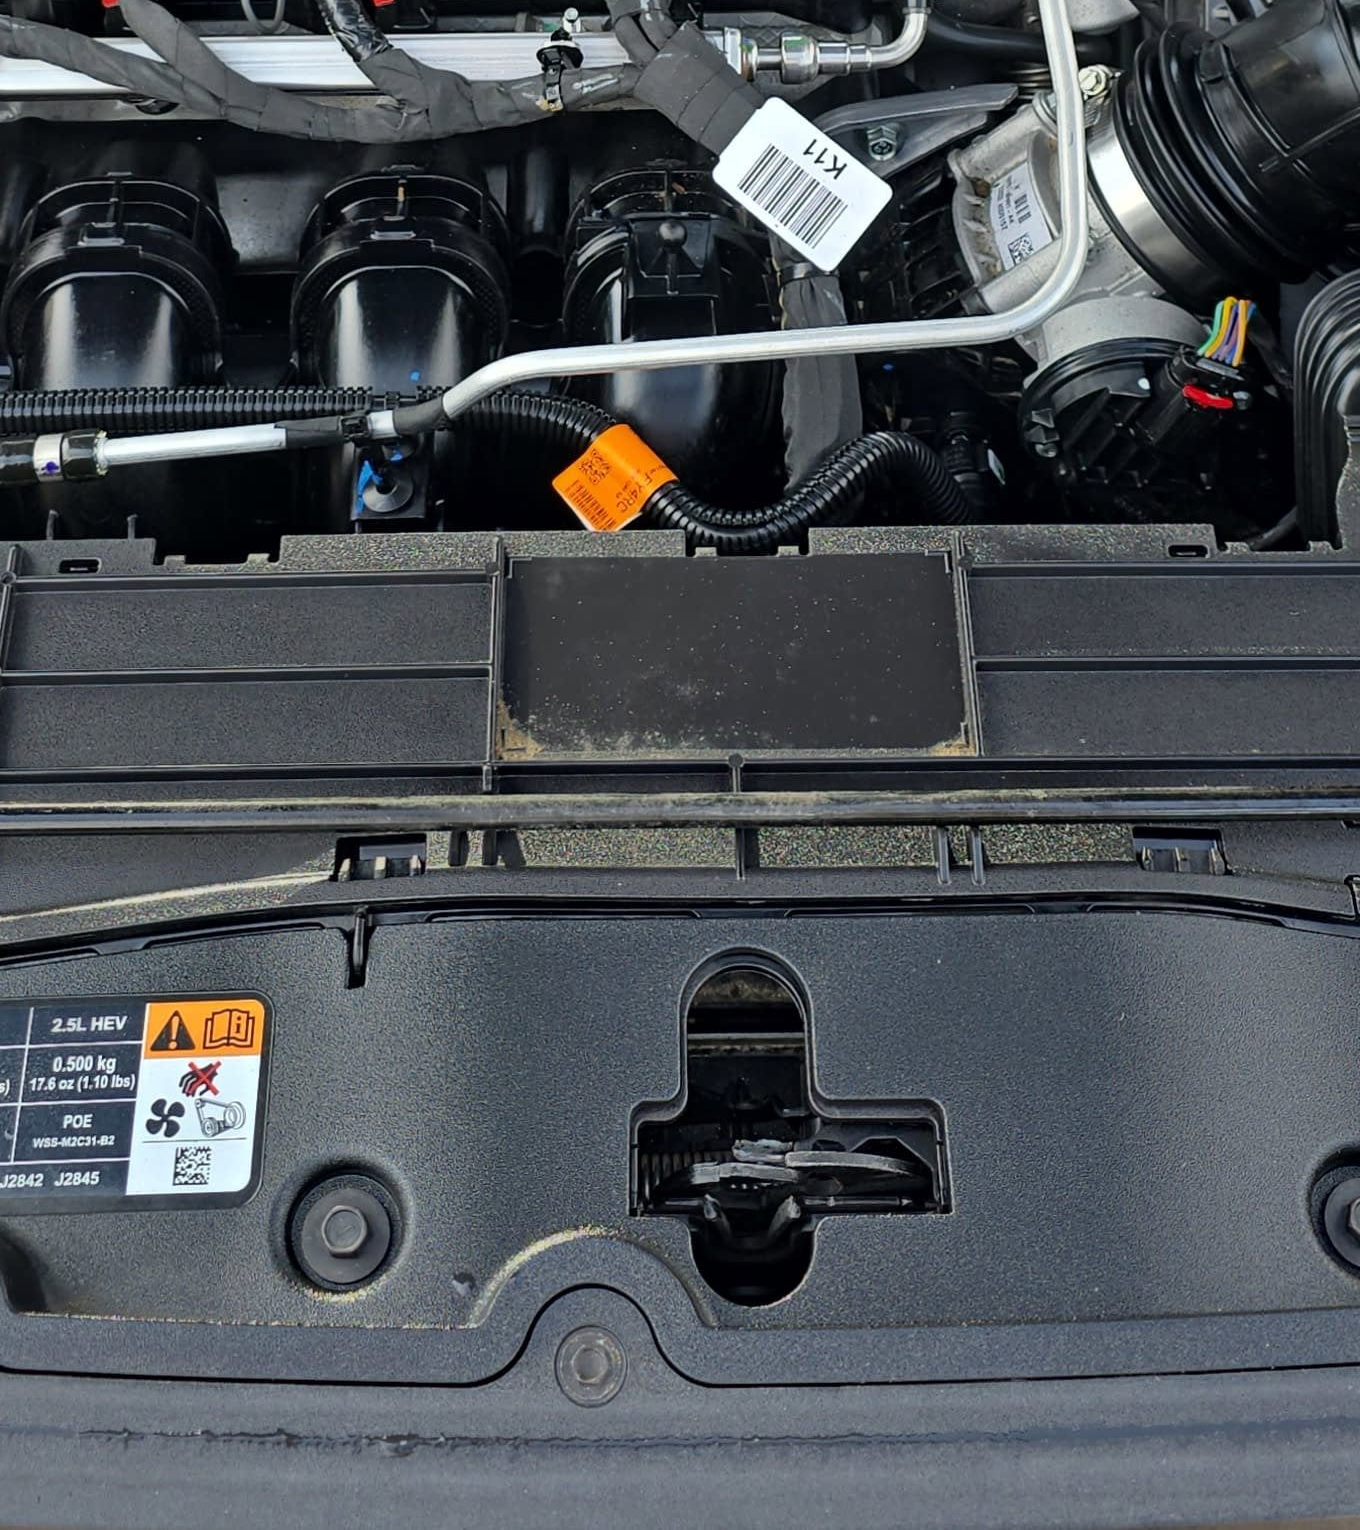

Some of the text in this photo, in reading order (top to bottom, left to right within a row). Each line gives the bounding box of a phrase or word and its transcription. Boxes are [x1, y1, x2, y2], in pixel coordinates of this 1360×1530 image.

[802, 138, 848, 180] K11
[50, 1015, 128, 1033] 2.5L HEV
[52, 1055, 117, 1074] 0.500 kg
[29, 1076, 58, 1092] 17.6
[58, 1079, 75, 1091] oz
[111, 1074, 136, 1092] lbs)
[62, 1114, 94, 1129] POE
[54, 1170, 101, 1187] J2845
